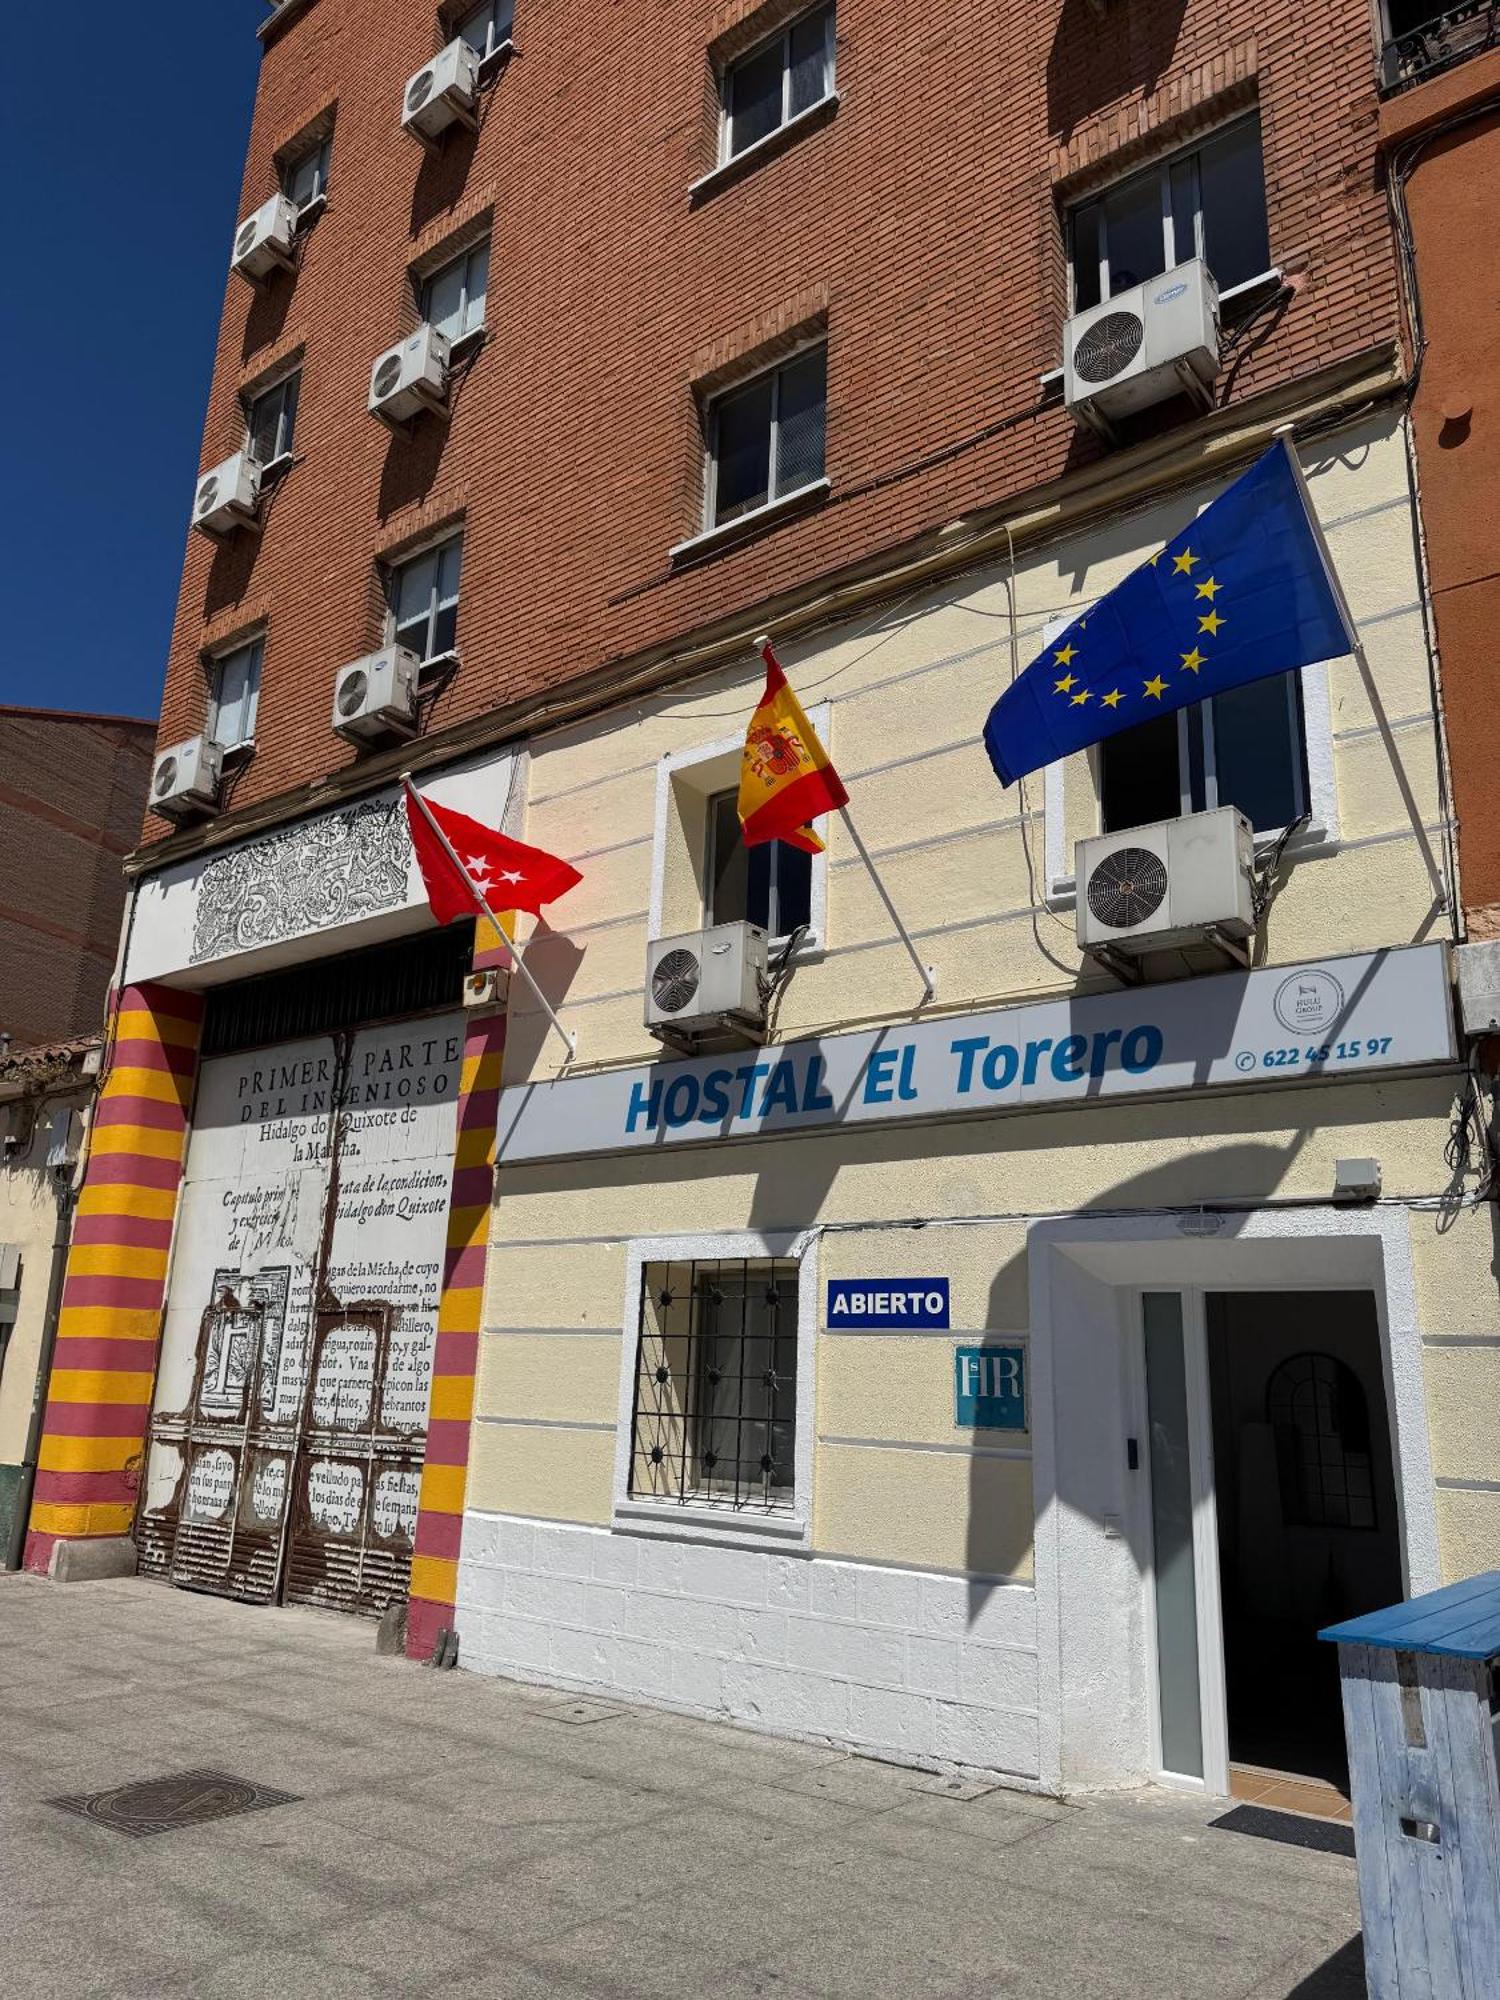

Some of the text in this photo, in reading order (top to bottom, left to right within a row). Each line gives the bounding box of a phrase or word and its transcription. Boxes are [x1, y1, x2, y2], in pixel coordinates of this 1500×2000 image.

[362, 1037, 459, 1077] PARTE
[1263, 1037, 1392, 1067] 622 45 15 97
[625, 1024, 1163, 1133] HOSTAL El Torero
[240, 1098, 287, 1122] DEL
[259, 1120, 307, 1144] Hidalgo
[340, 1110, 397, 1133] Quixote
[400, 1102, 417, 1124] de
[293, 1142, 303, 1162] la
[362, 1174, 376, 1193] de
[396, 1196, 446, 1221] Quixote
[415, 1263, 440, 1280] cuyo
[424, 1282, 438, 1293] no
[832, 1292, 944, 1314] ABIERTO
